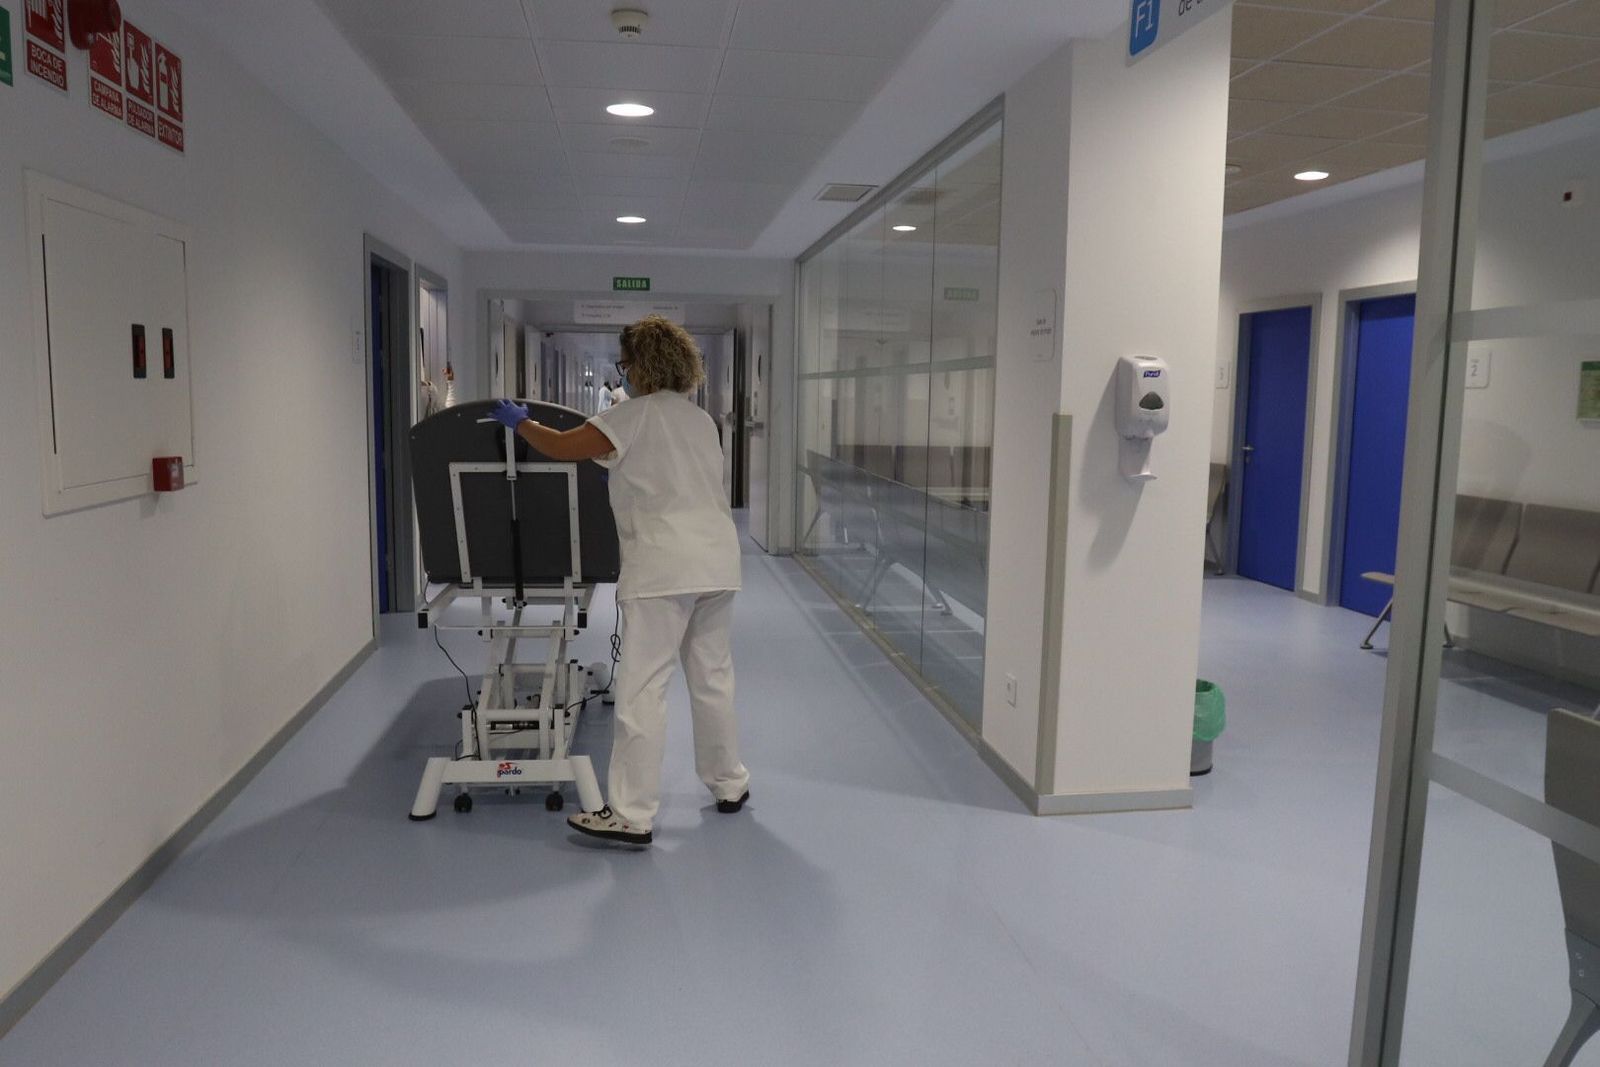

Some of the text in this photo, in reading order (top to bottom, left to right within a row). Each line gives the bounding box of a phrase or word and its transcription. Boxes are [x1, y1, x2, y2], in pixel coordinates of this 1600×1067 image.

[1135, 0, 1153, 39] F1
[31, 45, 64, 72] BOCA DE
[31, 61, 64, 87] INCENDIO
[616, 279, 647, 289] SALIDA
